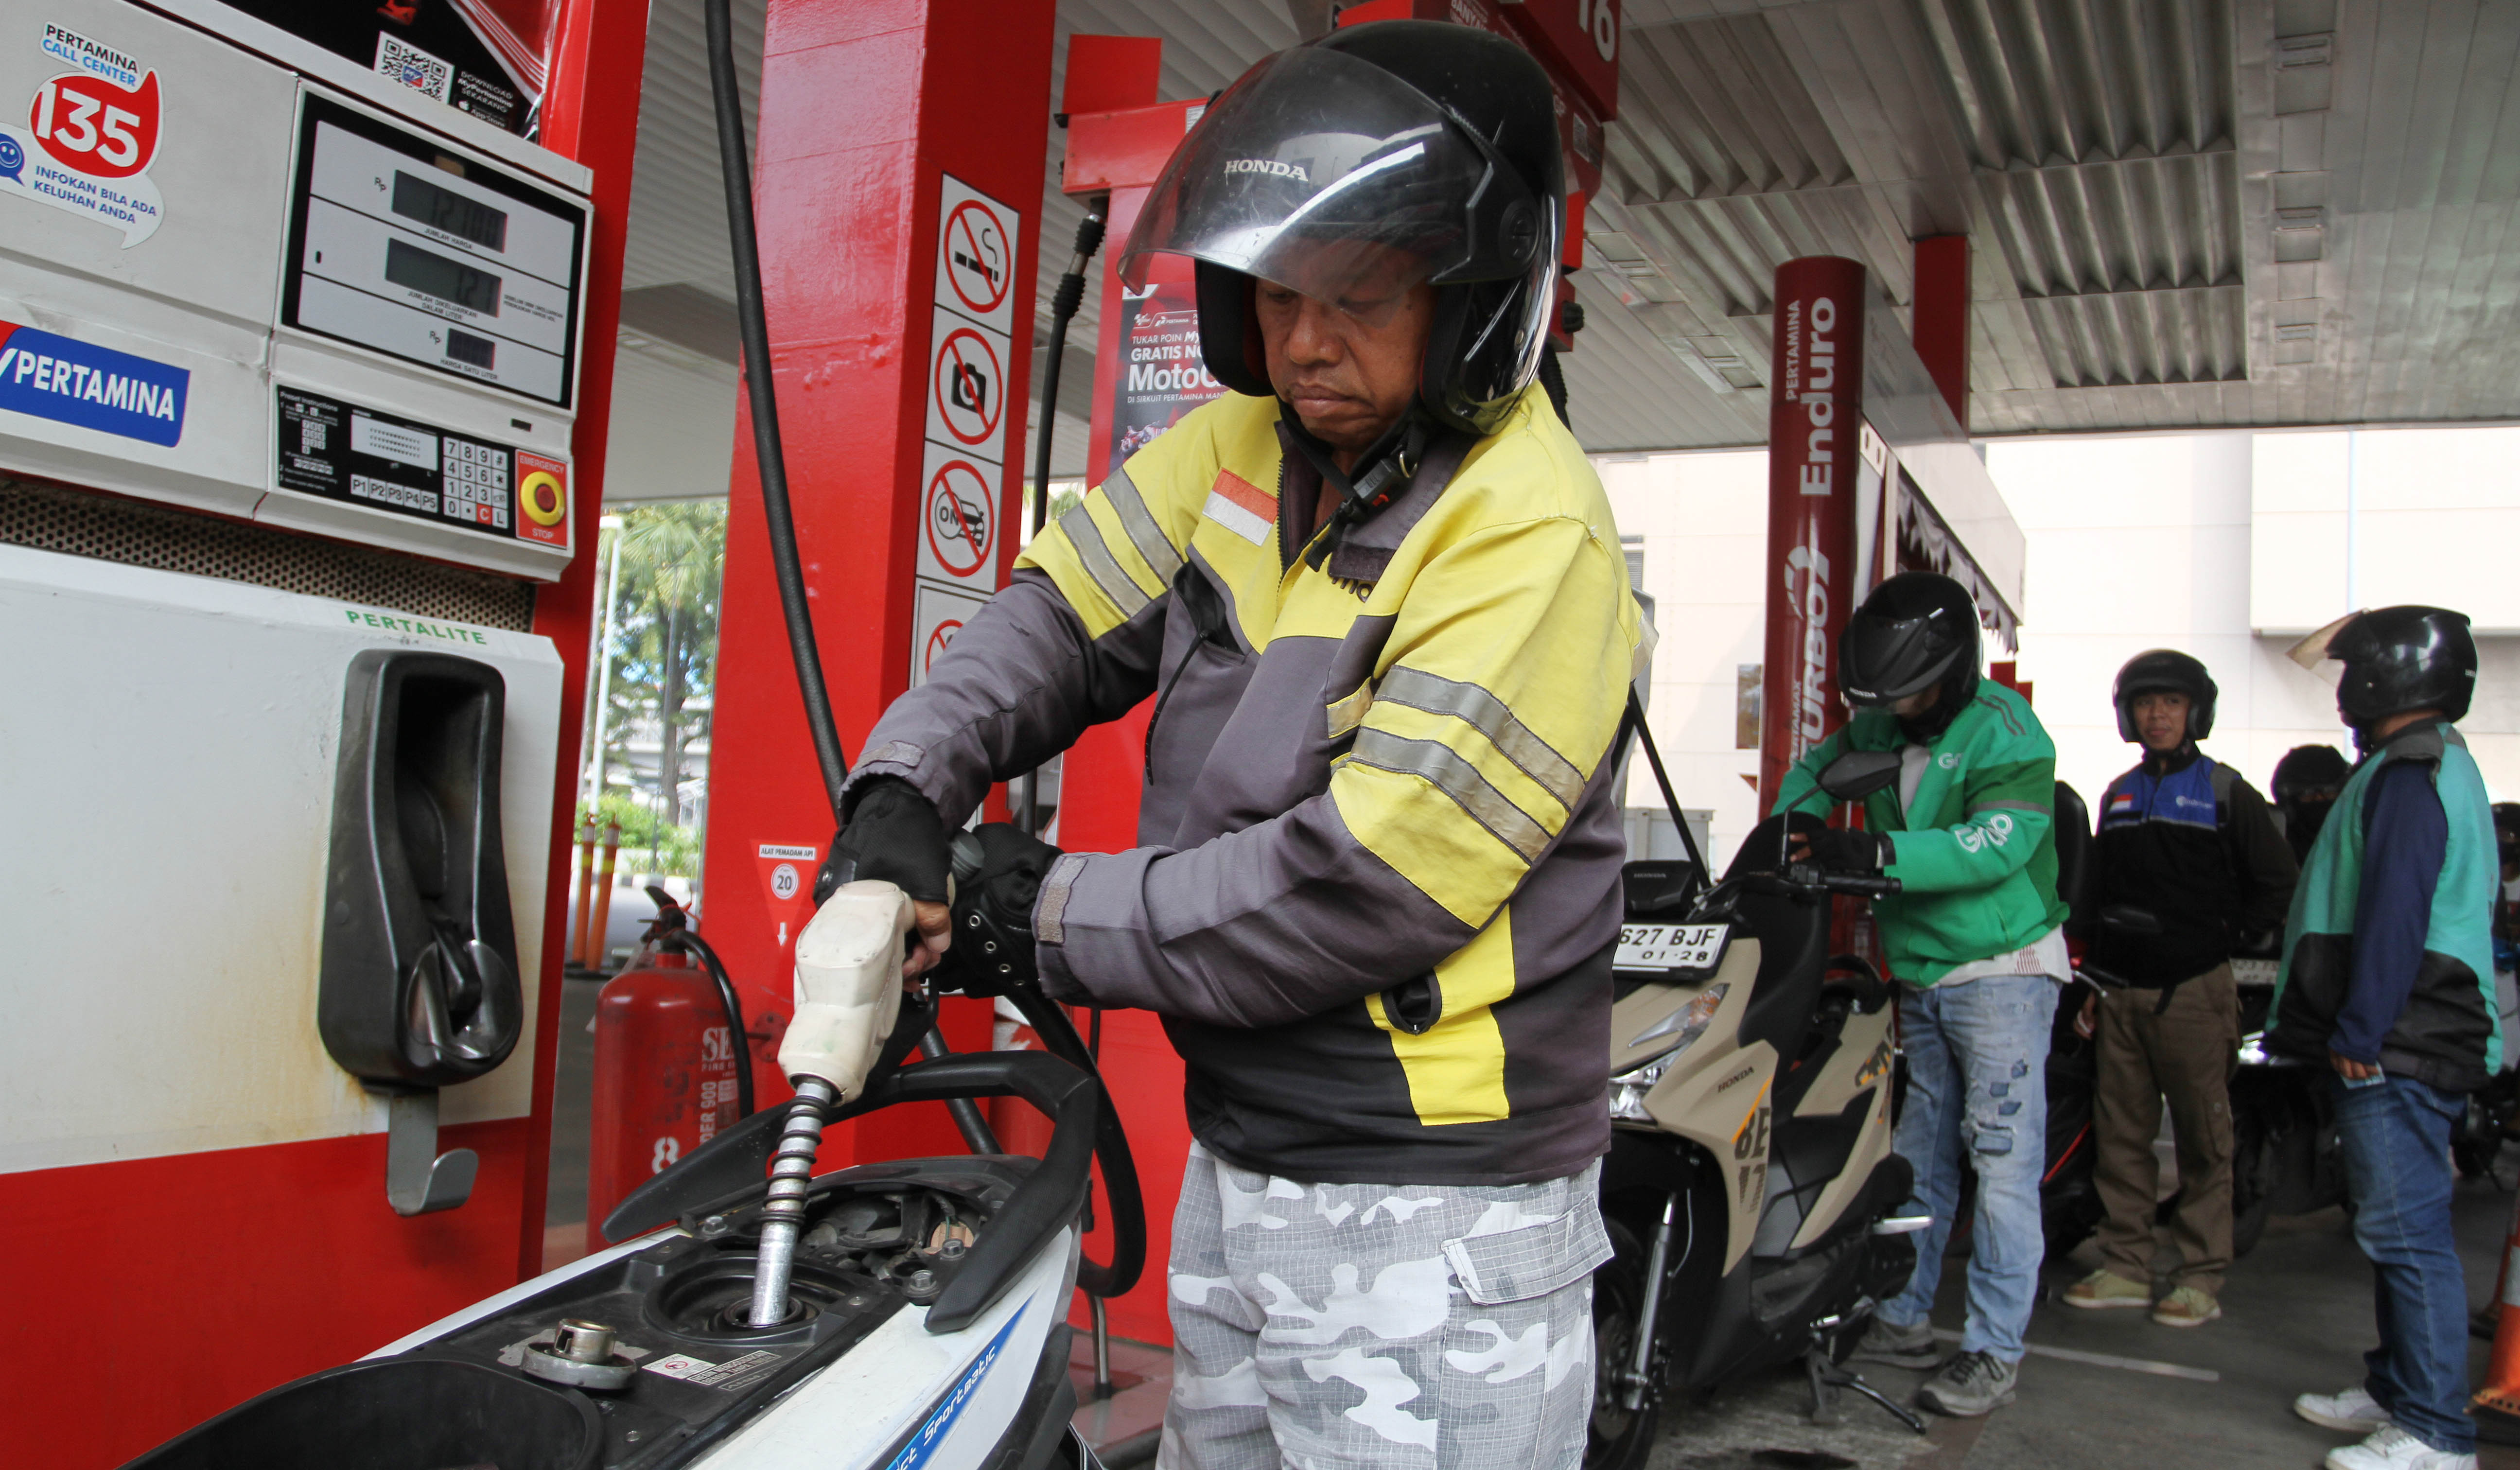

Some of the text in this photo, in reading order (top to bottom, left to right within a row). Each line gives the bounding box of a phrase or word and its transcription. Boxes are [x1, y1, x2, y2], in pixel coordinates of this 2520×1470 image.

[46, 24, 138, 74] PERTAMINA
[43, 39, 137, 87] CALL CENTER
[458, 78, 513, 107] MyPertamina
[461, 71, 513, 99] DOWNLOAD
[461, 88, 508, 112] SEKARANG
[36, 83, 140, 168] 135
[1224, 159, 1309, 181] HONDA
[35, 166, 157, 216] INFOKAN BILA ADA
[375, 177, 386, 192] Rp
[34, 181, 136, 223] KELUHAN ANDA
[424, 228, 449, 241] JUMLAH
[1132, 335, 1158, 344] TUKAR
[1160, 333, 1182, 343] POIN
[1785, 299, 1801, 401] PERTAMINA
[1131, 346, 1182, 361] GRATIS
[14, 349, 175, 421] PERTAMINA
[1136, 395, 1161, 403] SIRKUIT
[1163, 393, 1203, 402] PERTAMINA
[1800, 297, 1836, 495] Enduro
[448, 442, 455, 454] 7
[464, 446, 472, 458] 8
[480, 451, 488, 463] 9
[519, 455, 565, 474] EMERGENCY
[448, 462, 487, 482] 4 5 6
[352, 479, 366, 493] P1
[370, 483, 385, 497] P2
[388, 487, 403, 502] P3
[405, 492, 420, 507] P4
[422, 496, 436, 509] P5
[449, 482, 455, 494] 1
[464, 486, 472, 498] 2
[480, 489, 487, 501] 3
[449, 501, 504, 524] 0 C L
[532, 527, 553, 539] STOP
[345, 610, 487, 646] PERTALITE
[776, 875, 792, 891] 20
[1669, 928, 1717, 946] BJF
[1718, 1066, 1754, 1093] HONDA
[700, 1081, 717, 1109] 900
[699, 1112, 716, 1143] DER
[923, 1345, 995, 1447] Sportmatic
